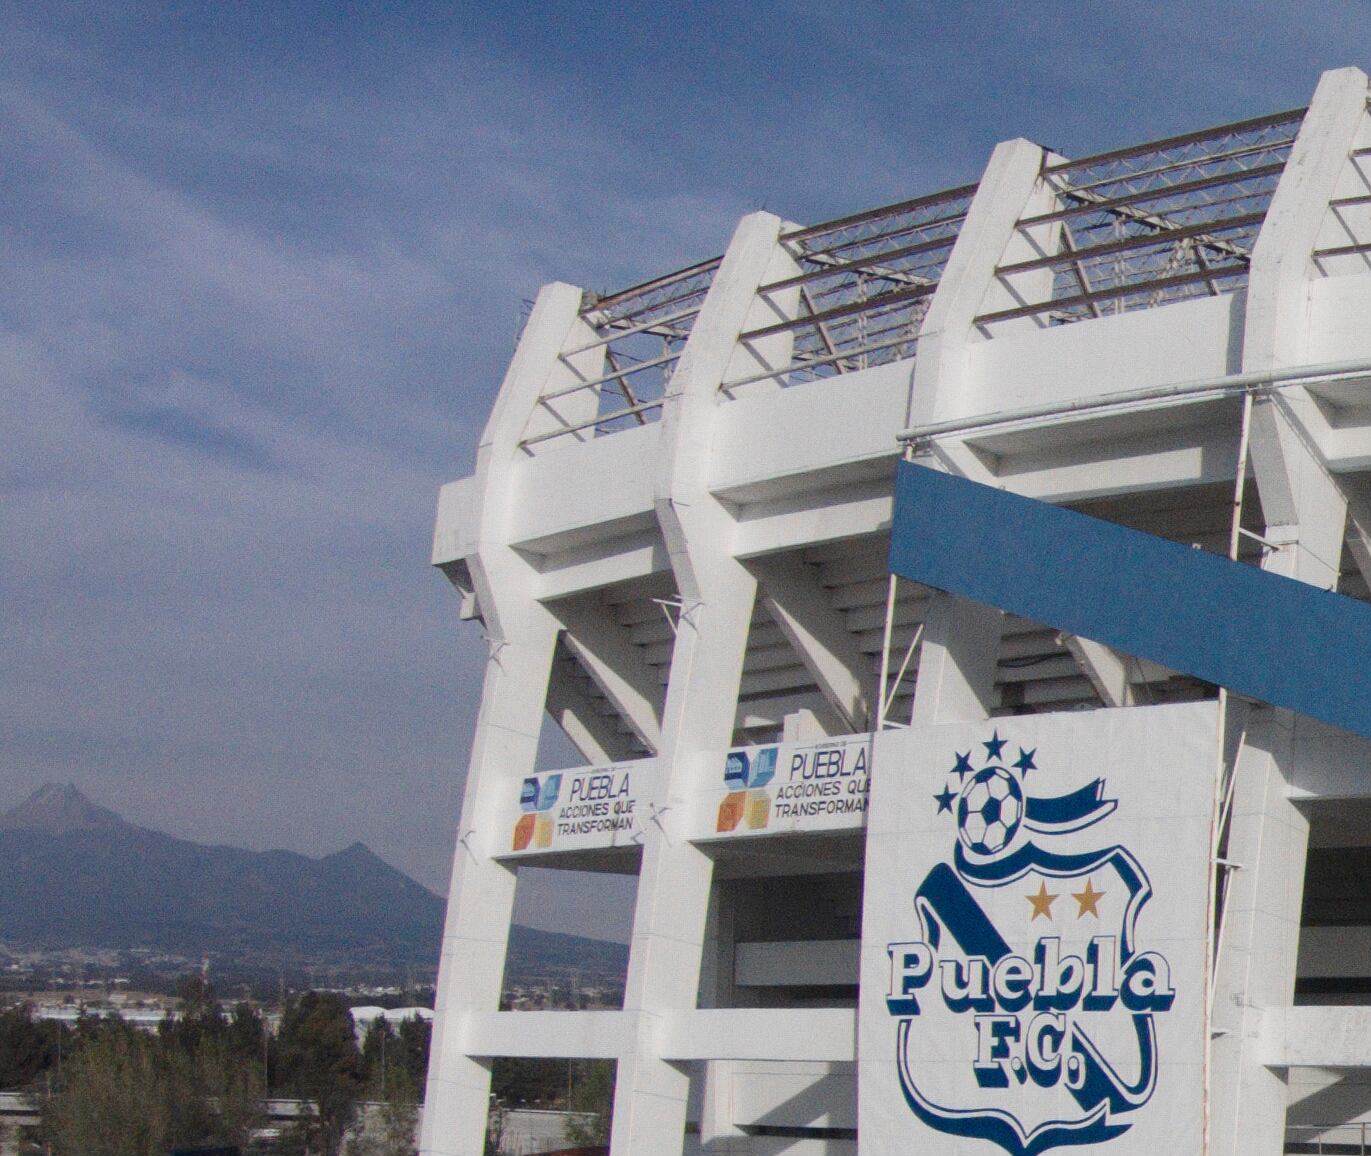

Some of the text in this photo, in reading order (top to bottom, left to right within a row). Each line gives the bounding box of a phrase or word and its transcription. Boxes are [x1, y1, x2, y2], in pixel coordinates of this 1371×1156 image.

[789, 747, 867, 781] PUEBLA
[570, 773, 629, 801] PUEBLA
[776, 781, 841, 800] ACCIONES
[559, 800, 636, 818] ACCIONES QUE
[557, 817, 634, 836] TRANSFORMAN
[886, 935, 1176, 1016] Puebla
[973, 1012, 1086, 1090] F.C.
